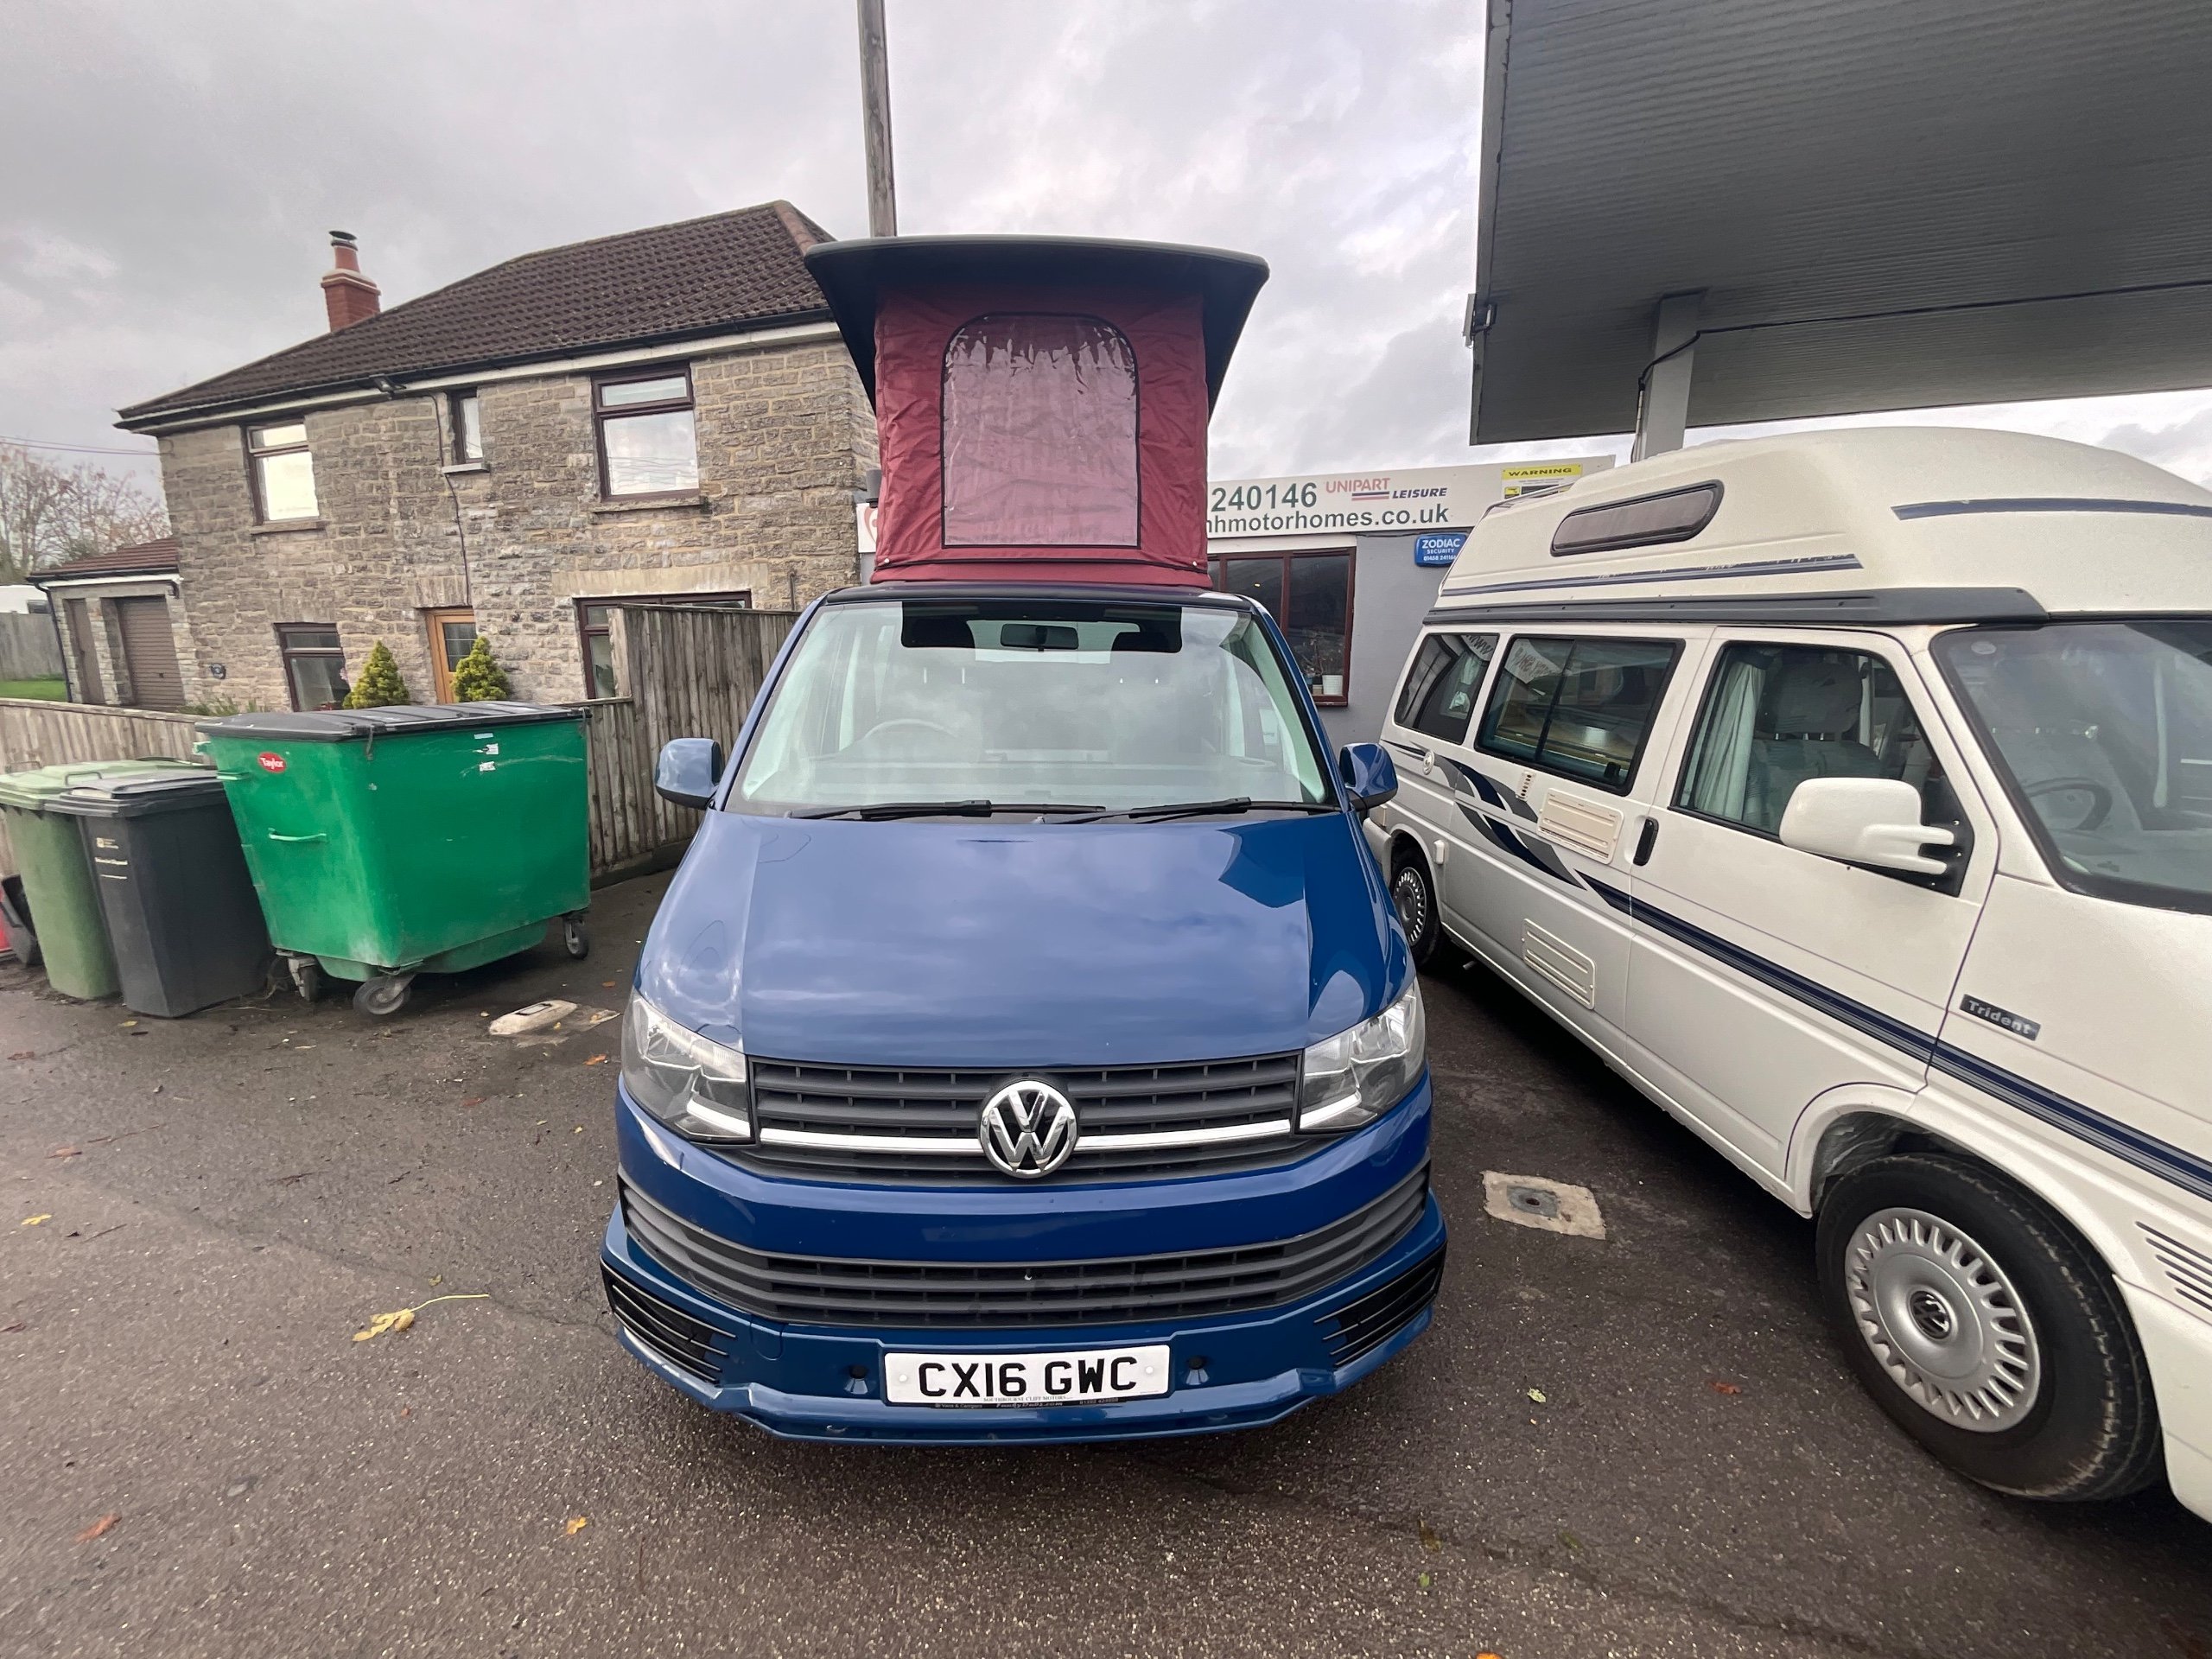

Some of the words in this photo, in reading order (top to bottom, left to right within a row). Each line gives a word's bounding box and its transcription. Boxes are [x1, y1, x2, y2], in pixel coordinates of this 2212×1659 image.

[1325, 478, 1390, 493] UNIPART
[1392, 487, 1447, 499] LEISURE
[1211, 482, 1317, 512] 240146
[1422, 538, 1460, 549] ZODIAC
[259, 757, 284, 769] Taylor
[1968, 1000, 2032, 1034] Trident
[984, 1084, 1074, 1176] VW
[918, 1362, 1027, 1398] CX16
[1045, 1357, 1138, 1395] GWC
